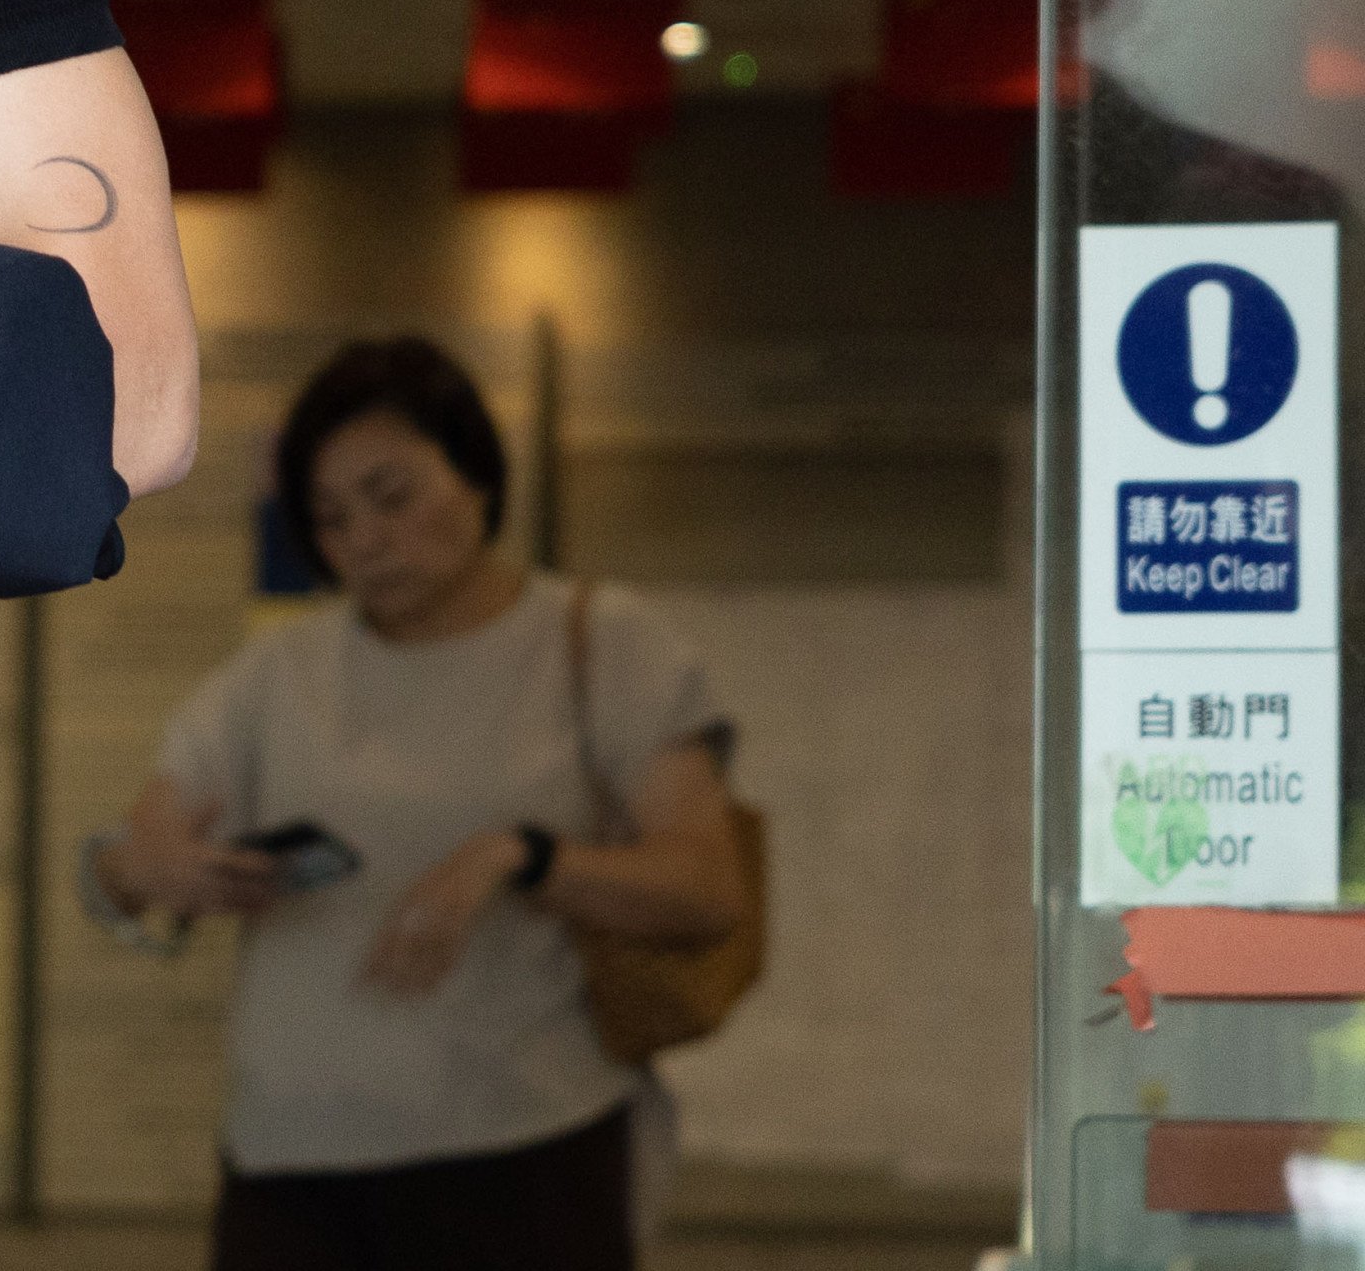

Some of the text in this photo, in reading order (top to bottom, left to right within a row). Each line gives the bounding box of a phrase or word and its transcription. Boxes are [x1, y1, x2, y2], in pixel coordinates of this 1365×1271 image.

[1127, 494, 1290, 544] 請勿靠近
[1127, 553, 1290, 601] Keep Clear
[1139, 691, 1290, 740] 自動門
[1116, 762, 1304, 804] Automatic
